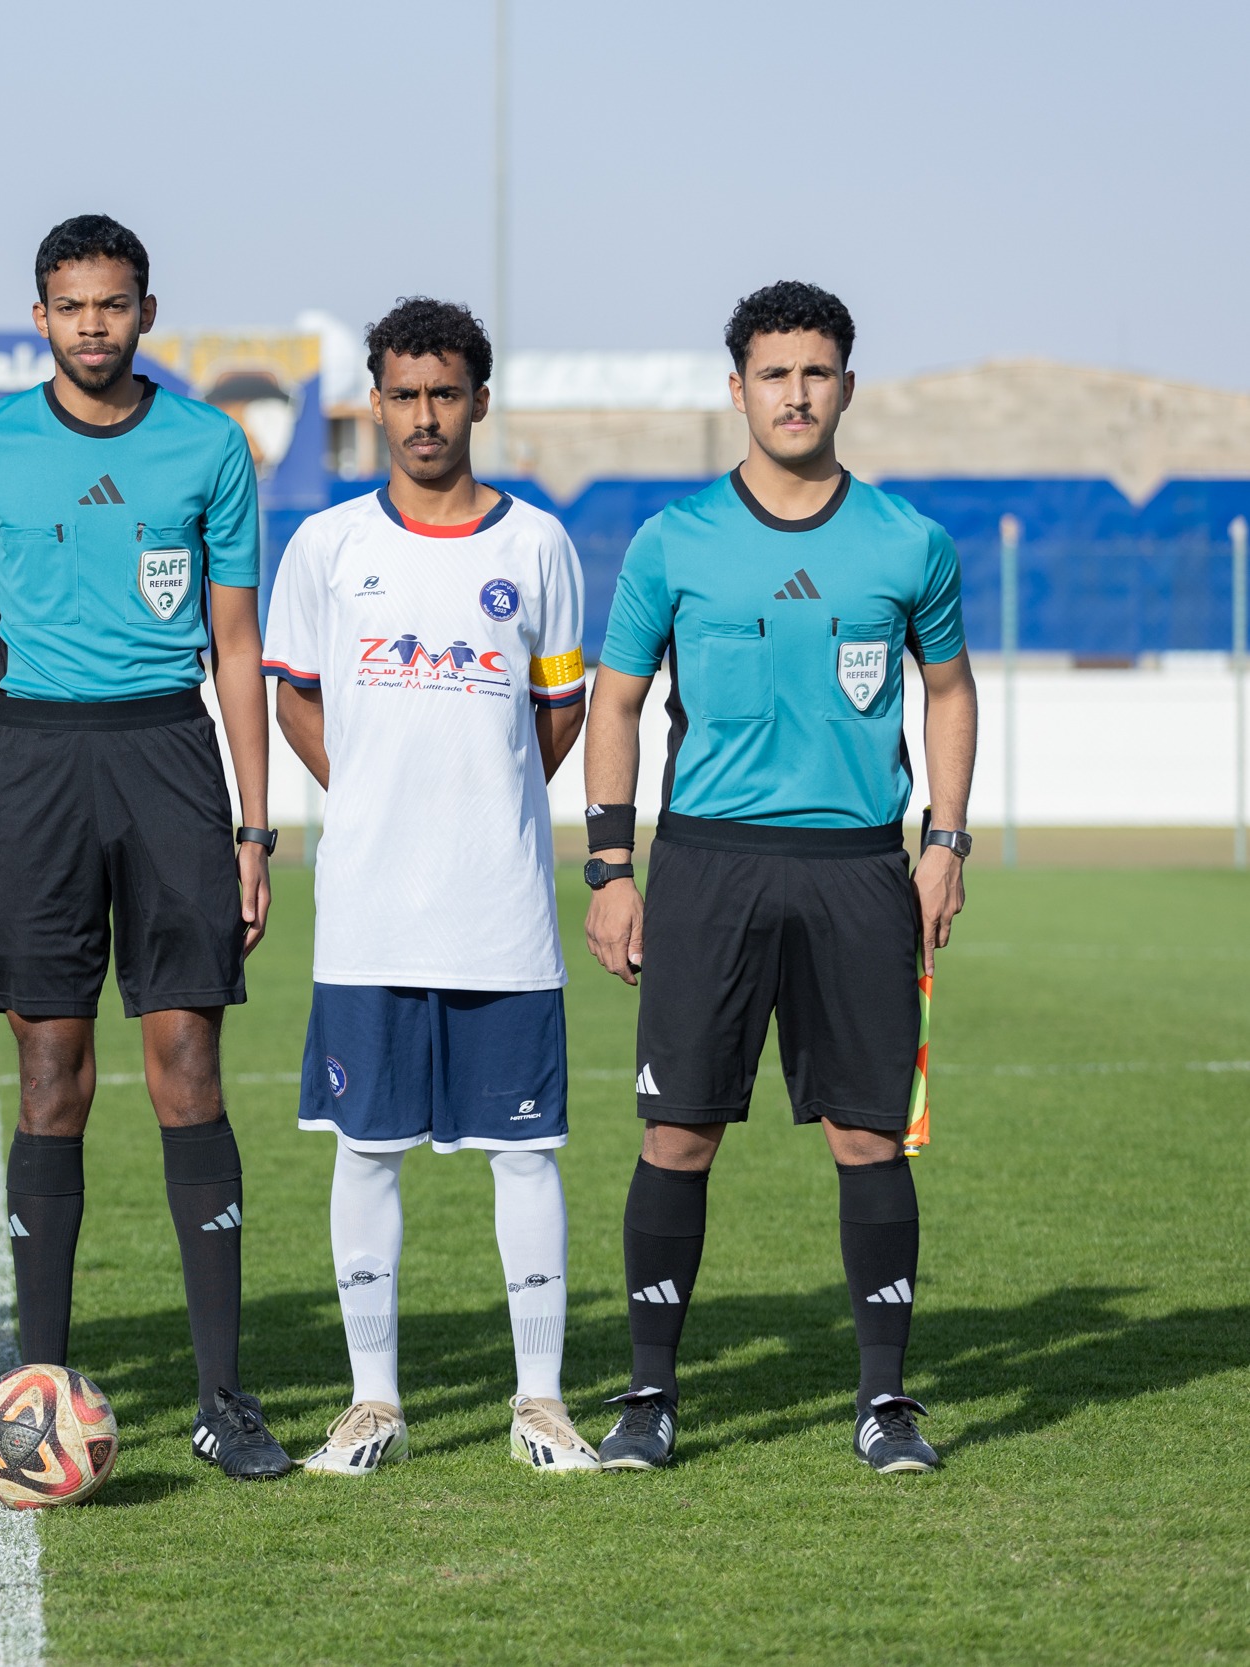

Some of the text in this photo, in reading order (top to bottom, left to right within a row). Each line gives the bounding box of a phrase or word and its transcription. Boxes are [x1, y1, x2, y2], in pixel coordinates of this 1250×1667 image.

[146, 558, 187, 577] SAFF
[149, 579, 183, 588] REFEREE
[843, 650, 883, 668] SAFF
[846, 670, 878, 679] REFEREE
